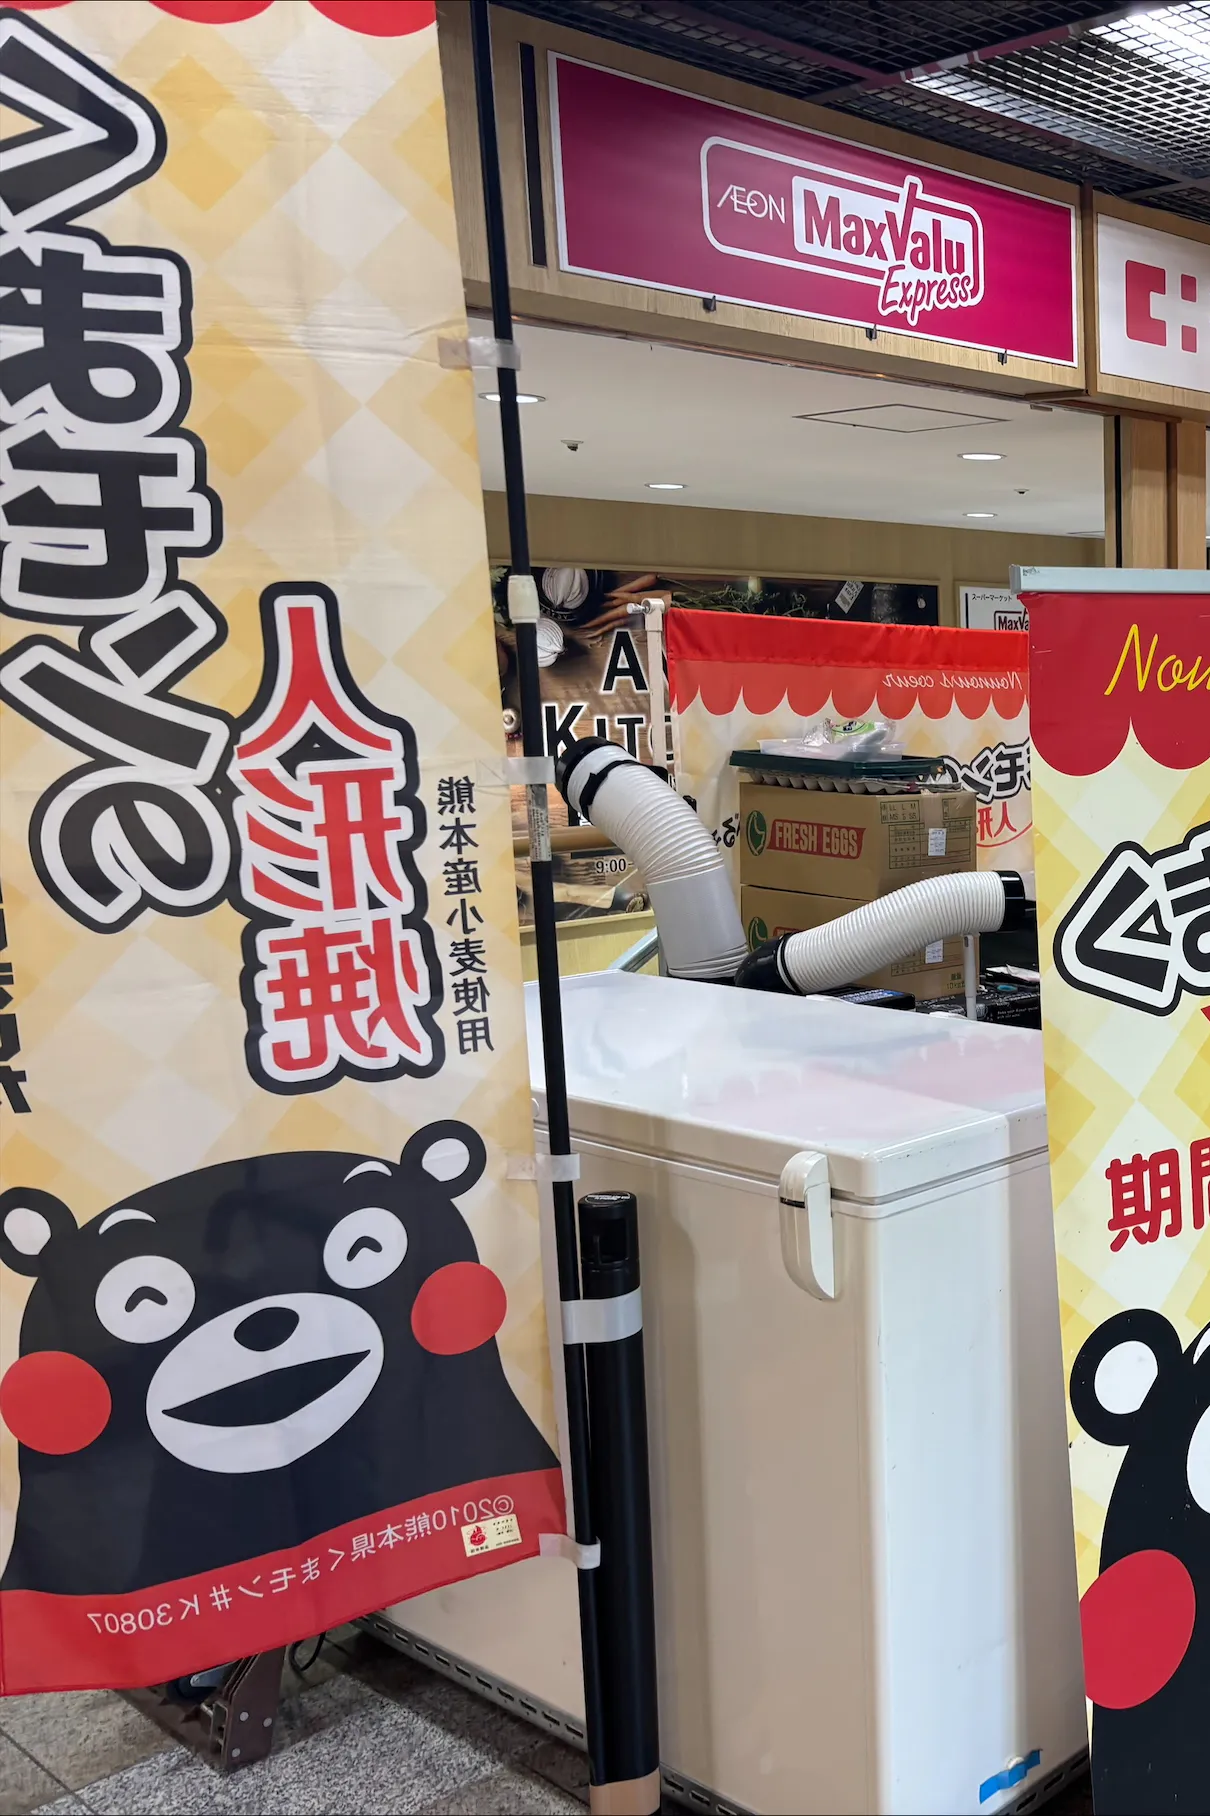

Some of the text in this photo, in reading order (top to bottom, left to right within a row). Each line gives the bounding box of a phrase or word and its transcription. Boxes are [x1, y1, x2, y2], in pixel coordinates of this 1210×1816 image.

[803, 178, 966, 277] MaxValu
[880, 263, 973, 324] Express
[971, 593, 1013, 602] スーパーマーケット
[774, 820, 818, 852] FRESH
[822, 827, 859, 857] EGGS
